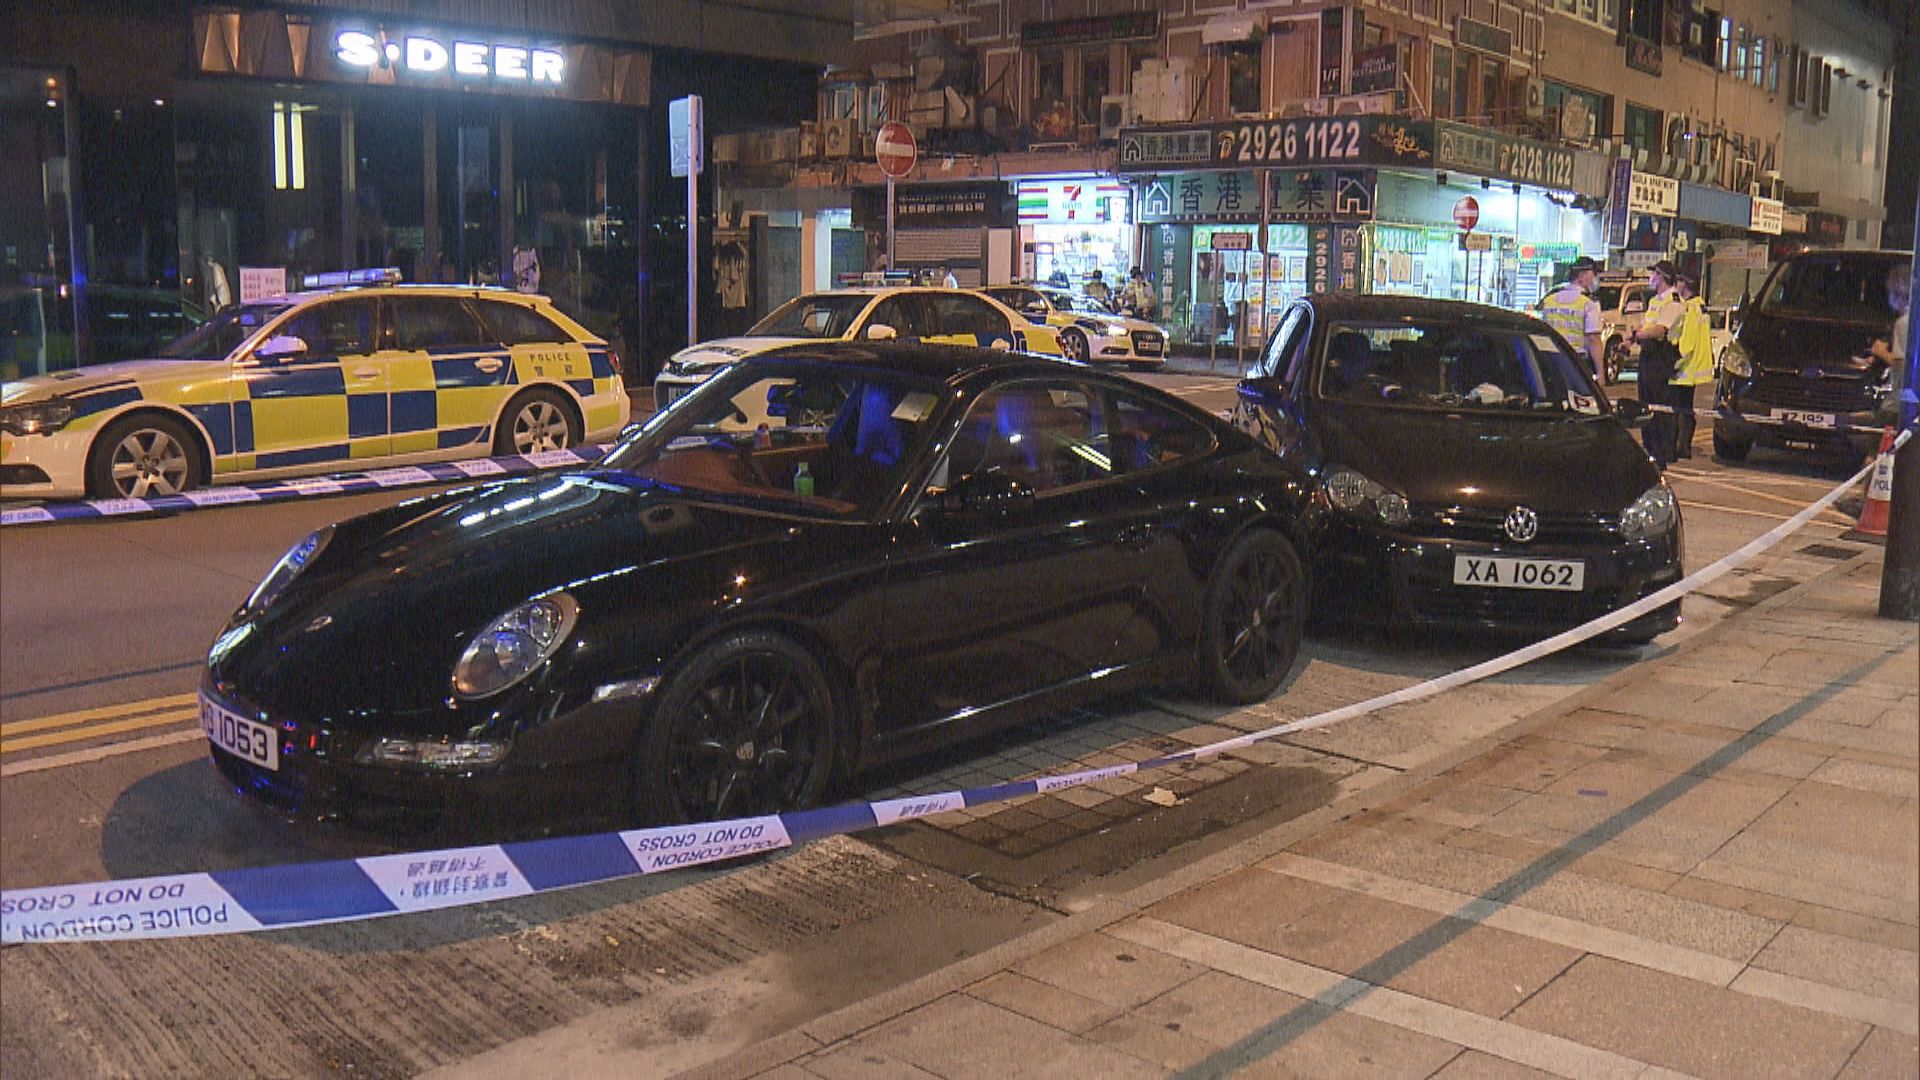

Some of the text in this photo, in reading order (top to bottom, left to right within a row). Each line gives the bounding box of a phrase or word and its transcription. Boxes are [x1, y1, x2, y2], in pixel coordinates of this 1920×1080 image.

[1238, 122, 1297, 161] 2926
[1305, 120, 1360, 159] 1122
[1511, 143, 1543, 181] 2926
[1545, 150, 1572, 187] 1122
[529, 352, 571, 362] POLICE
[1466, 560, 1574, 585] XA 1062
[218, 709, 268, 762] 1053
[637, 824, 764, 853] DO NOT CROSS
[89, 886, 143, 907] NOT
[148, 883, 185, 900] DO
[139, 903, 229, 926] POLICE
